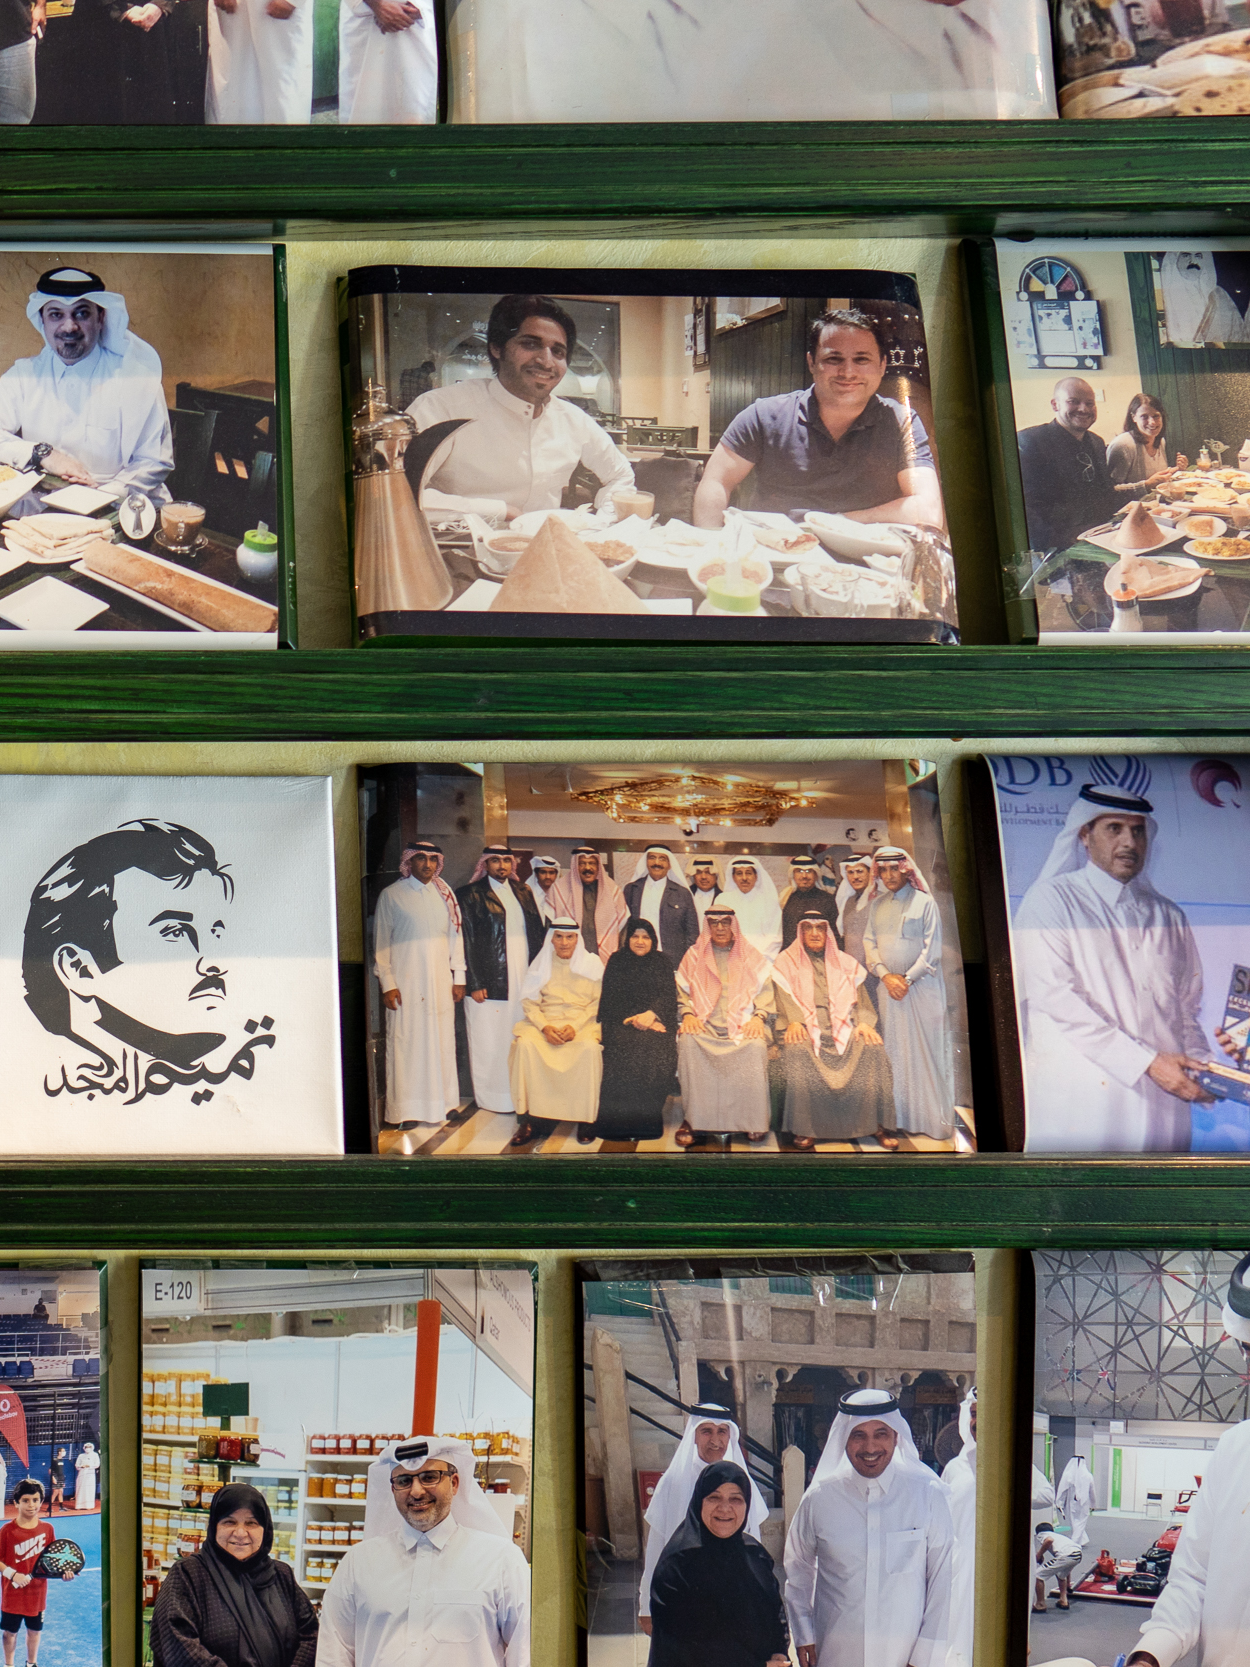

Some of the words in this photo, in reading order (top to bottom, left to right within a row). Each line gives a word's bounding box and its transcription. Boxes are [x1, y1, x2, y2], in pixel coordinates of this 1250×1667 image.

[43, 1048, 140, 1102] المجد
[123, 1014, 276, 1106] تميم
[154, 1281, 192, 1301] E-120
[14, 1532, 47, 1564] NIKE
